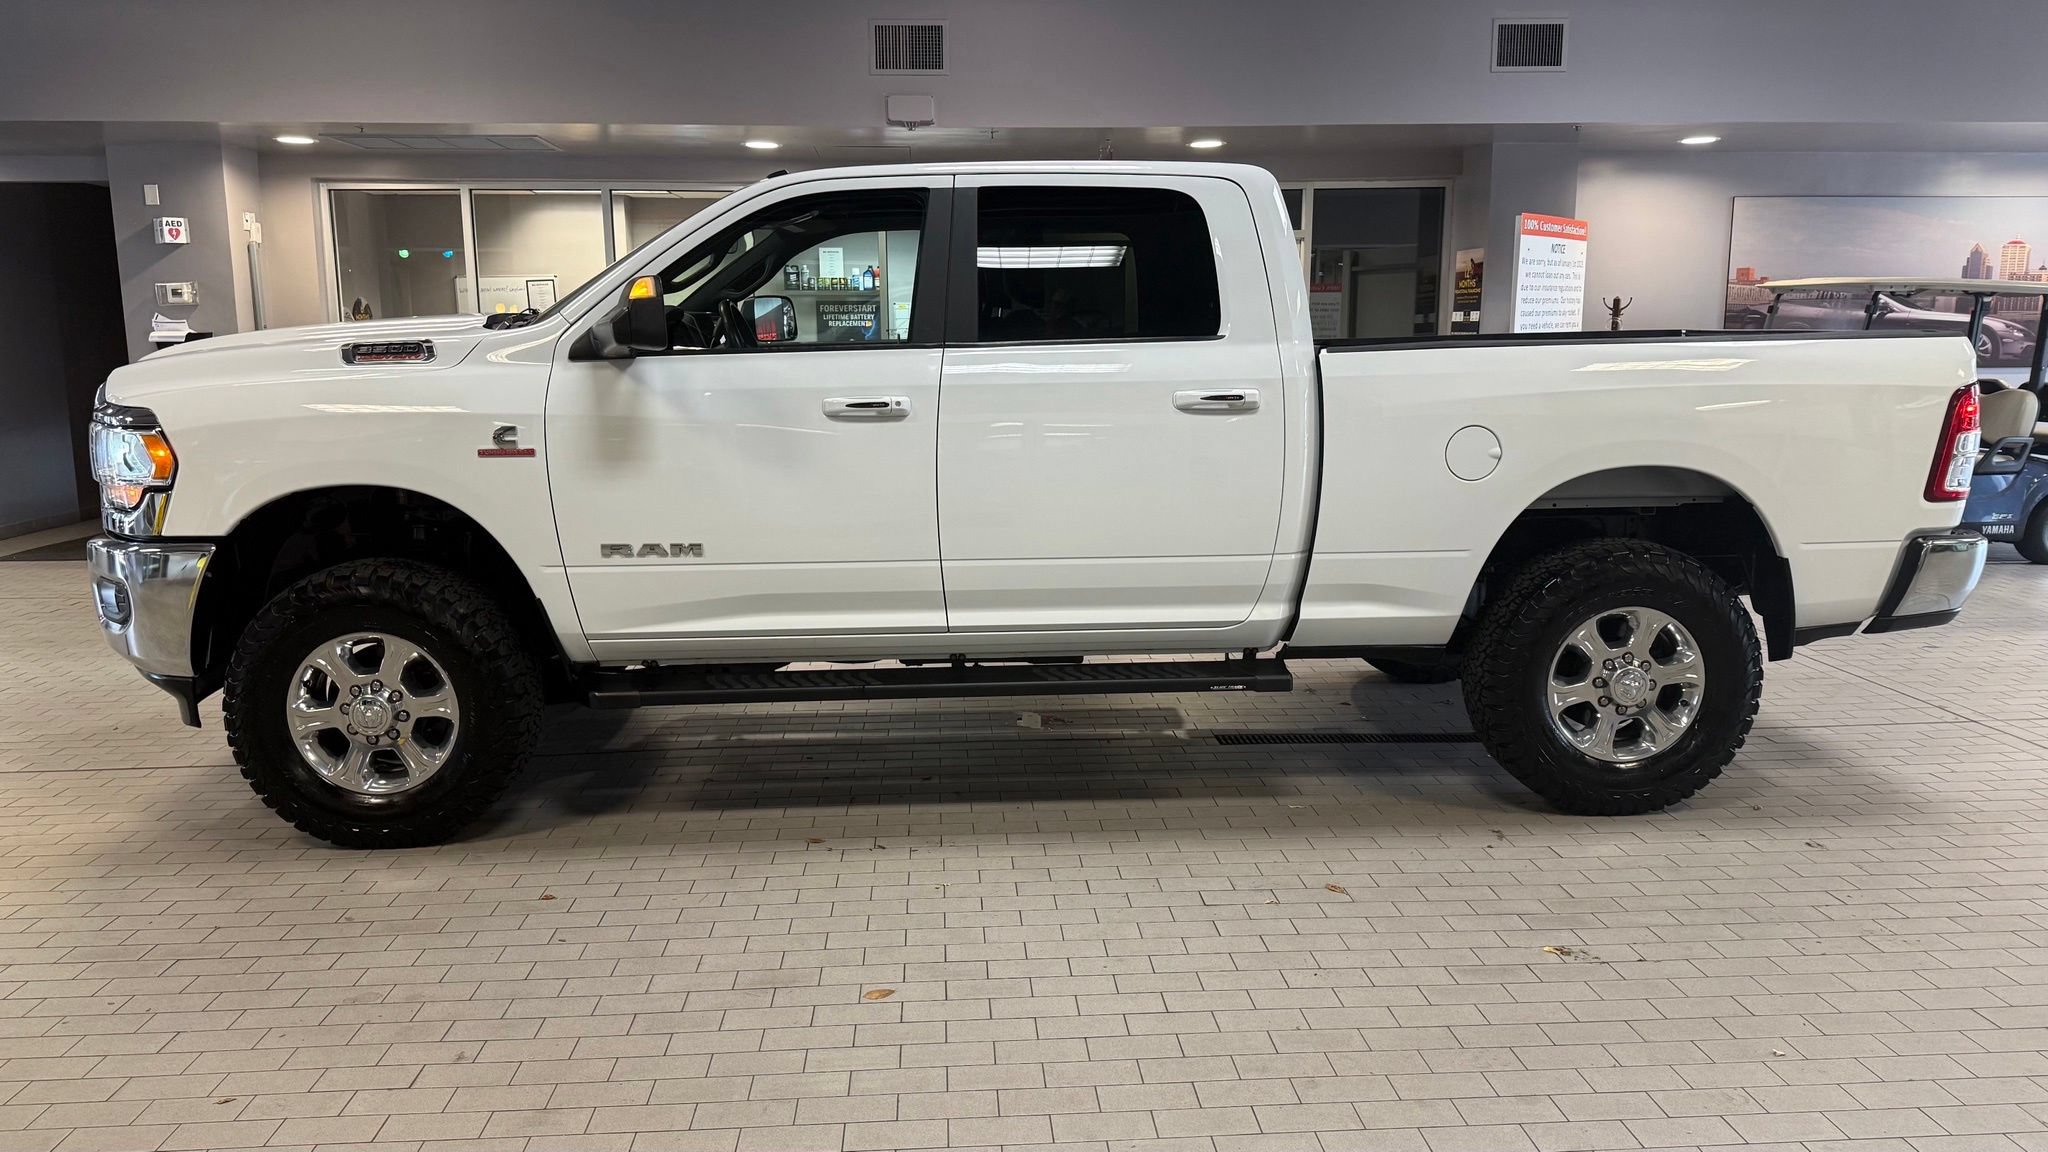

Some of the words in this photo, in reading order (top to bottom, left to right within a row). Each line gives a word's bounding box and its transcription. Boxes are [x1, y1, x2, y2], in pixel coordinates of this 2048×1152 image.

[1524, 219, 1539, 230] 100%
[1540, 221, 1562, 232] Customer
[1551, 244, 1566, 254] NOTICE
[1982, 525, 2014, 534] YAMAHA
[600, 544, 703, 558] RAM
